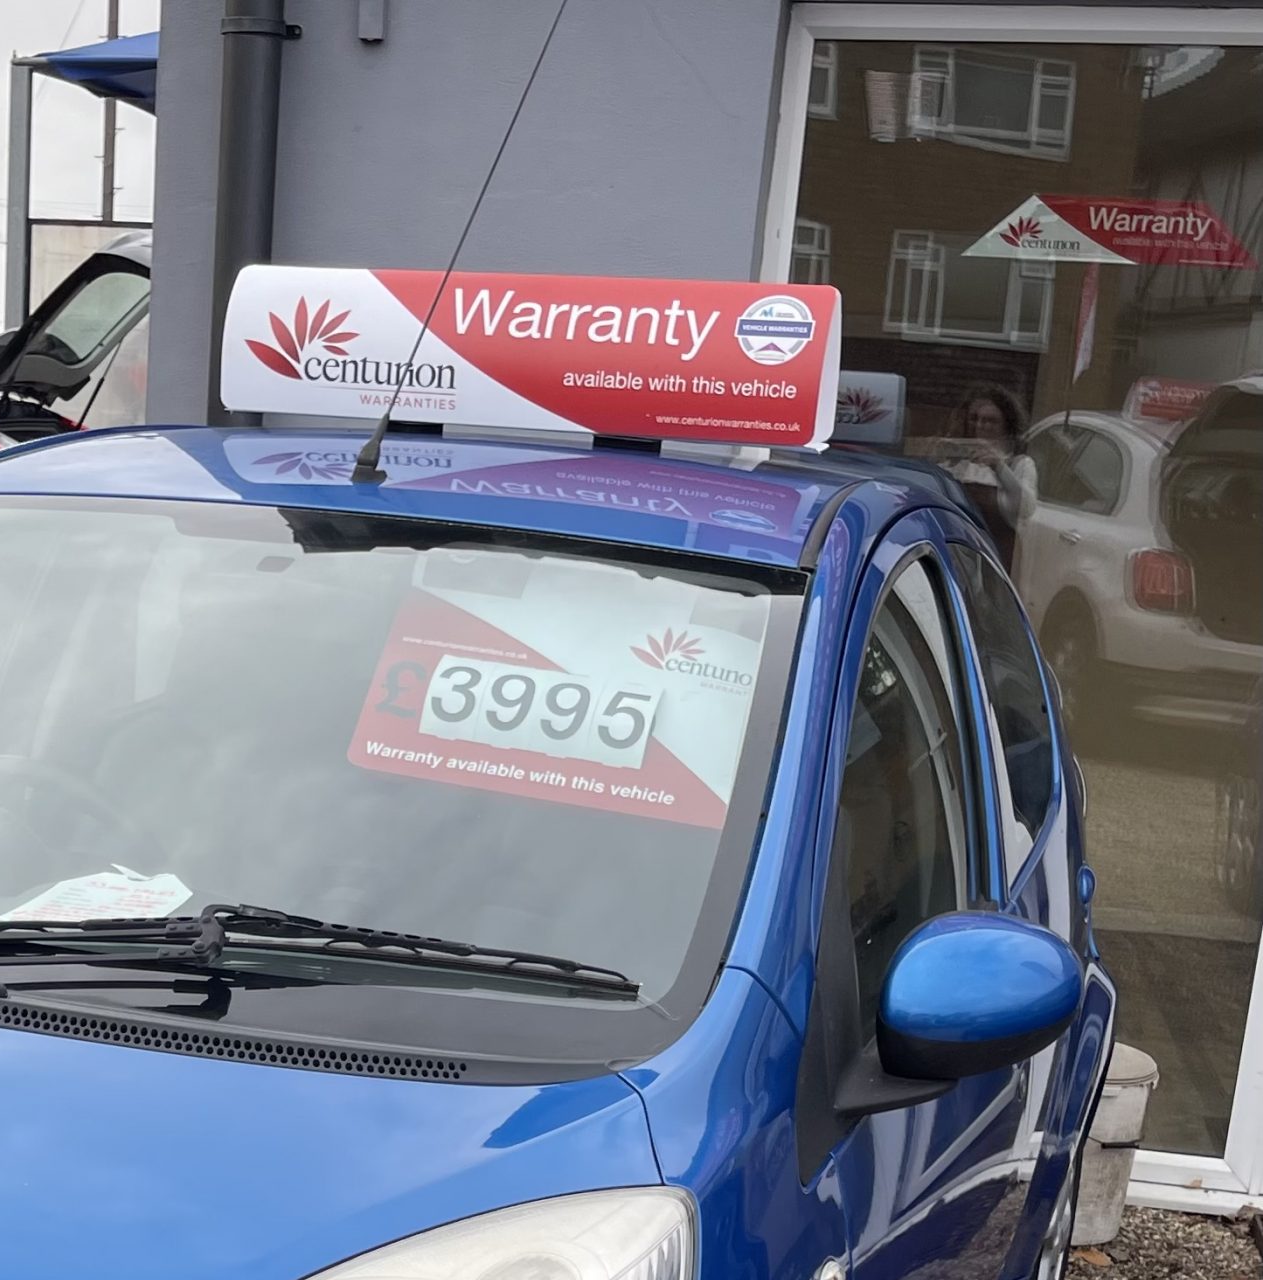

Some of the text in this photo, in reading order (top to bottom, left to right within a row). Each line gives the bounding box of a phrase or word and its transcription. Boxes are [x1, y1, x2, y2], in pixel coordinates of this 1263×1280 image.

[1089, 206, 1212, 241] Warranty
[454, 288, 721, 361] Warranty
[304, 357, 456, 389] centurion
[563, 370, 797, 399] available with this vehicle
[360, 394, 456, 410] WARRANTIES
[655, 415, 801, 432] www.centurionwarranties.co.uk
[367, 740, 674, 805] Warranty available with this vehicle
